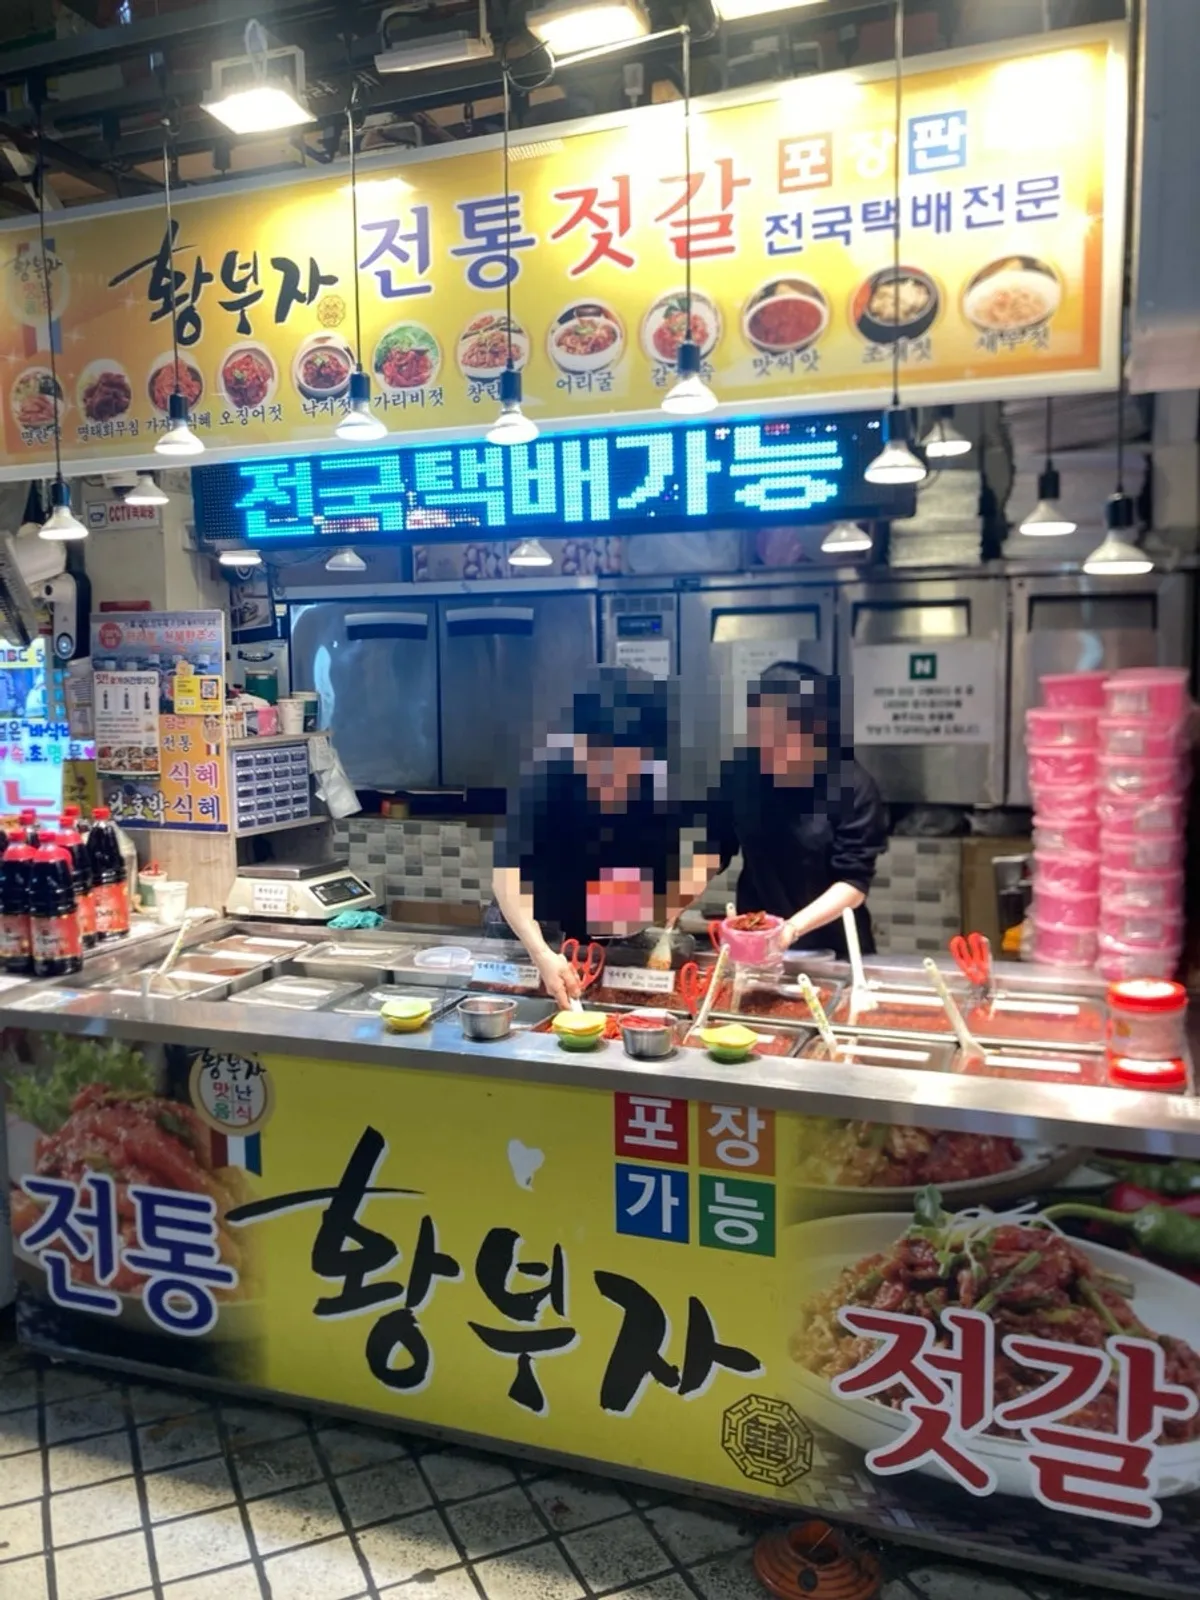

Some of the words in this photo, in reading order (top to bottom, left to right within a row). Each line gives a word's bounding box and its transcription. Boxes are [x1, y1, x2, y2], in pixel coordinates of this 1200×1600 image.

[108, 219, 338, 346] 황부자
[145, 413, 211, 433] 가자식혜
[219, 404, 282, 426] 오징어젓
[302, 397, 351, 419] 낙지젓
[374, 387, 445, 411] 가리비젓
[556, 371, 615, 394] 어리굴
[651, 362, 715, 388] 갈속
[235, 424, 843, 538] 전국택배가능
[168, 762, 218, 788] 식혜
[20, 1174, 237, 1332] 전통
[225, 1125, 763, 1414] 황부자
[836, 1310, 1195, 1524] 젓갈
